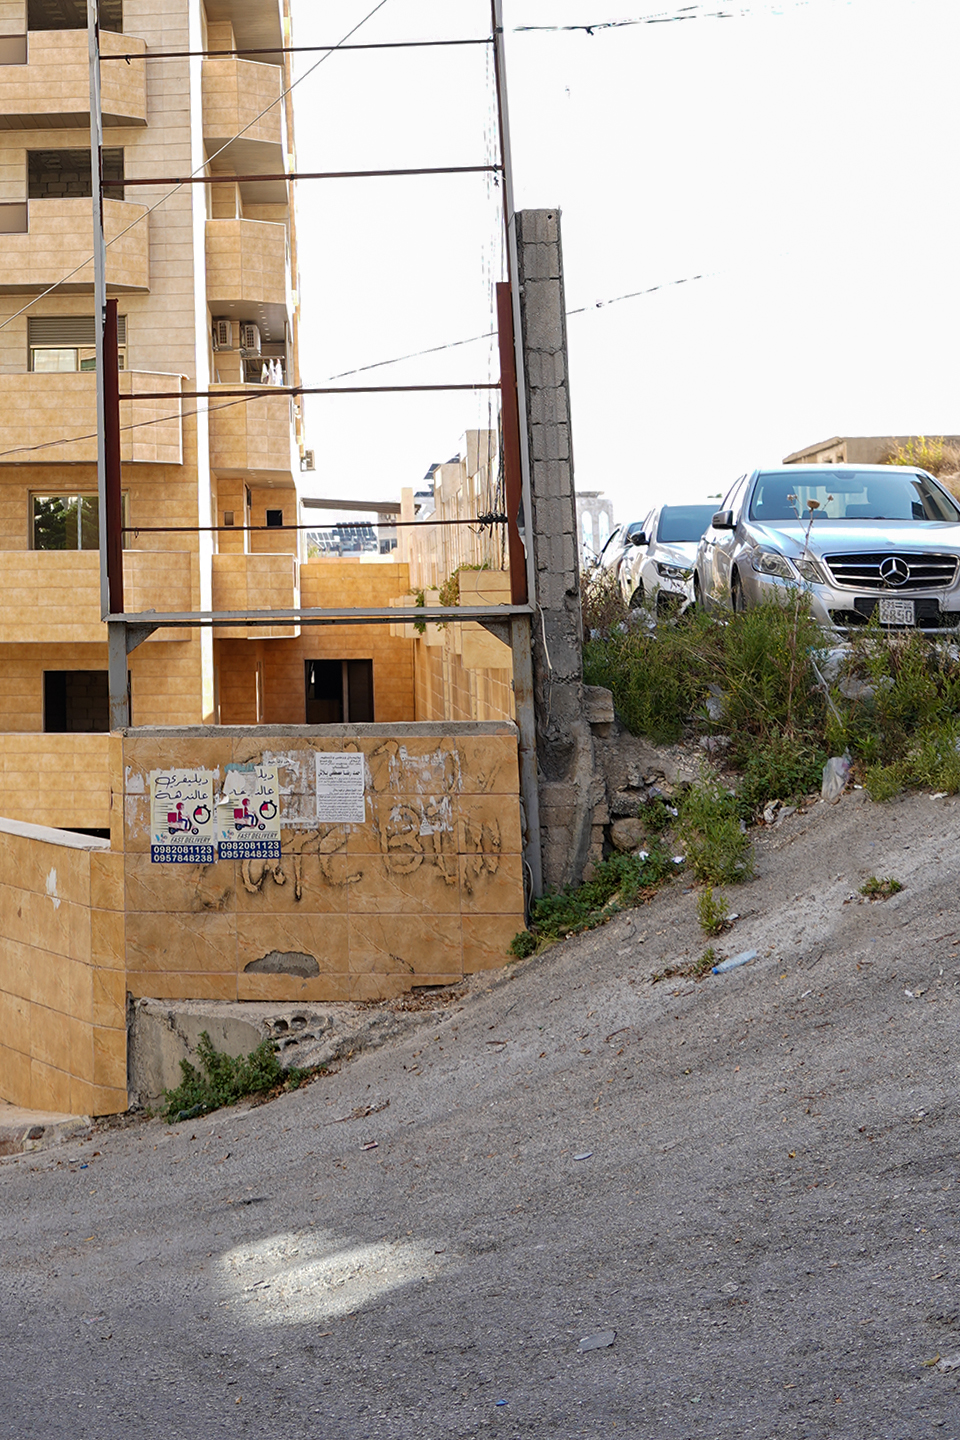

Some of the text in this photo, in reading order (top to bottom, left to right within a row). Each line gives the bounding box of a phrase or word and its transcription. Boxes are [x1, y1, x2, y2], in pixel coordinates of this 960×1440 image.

[154, 773, 208, 789] ديليفري
[170, 836, 211, 844] FAST DELIVERY
[237, 832, 251, 840] FAST
[153, 846, 212, 854] 0982081123
[220, 842, 280, 850] 0982081123
[153, 854, 212, 862] 0957848238
[221, 850, 280, 858] 0957848238
